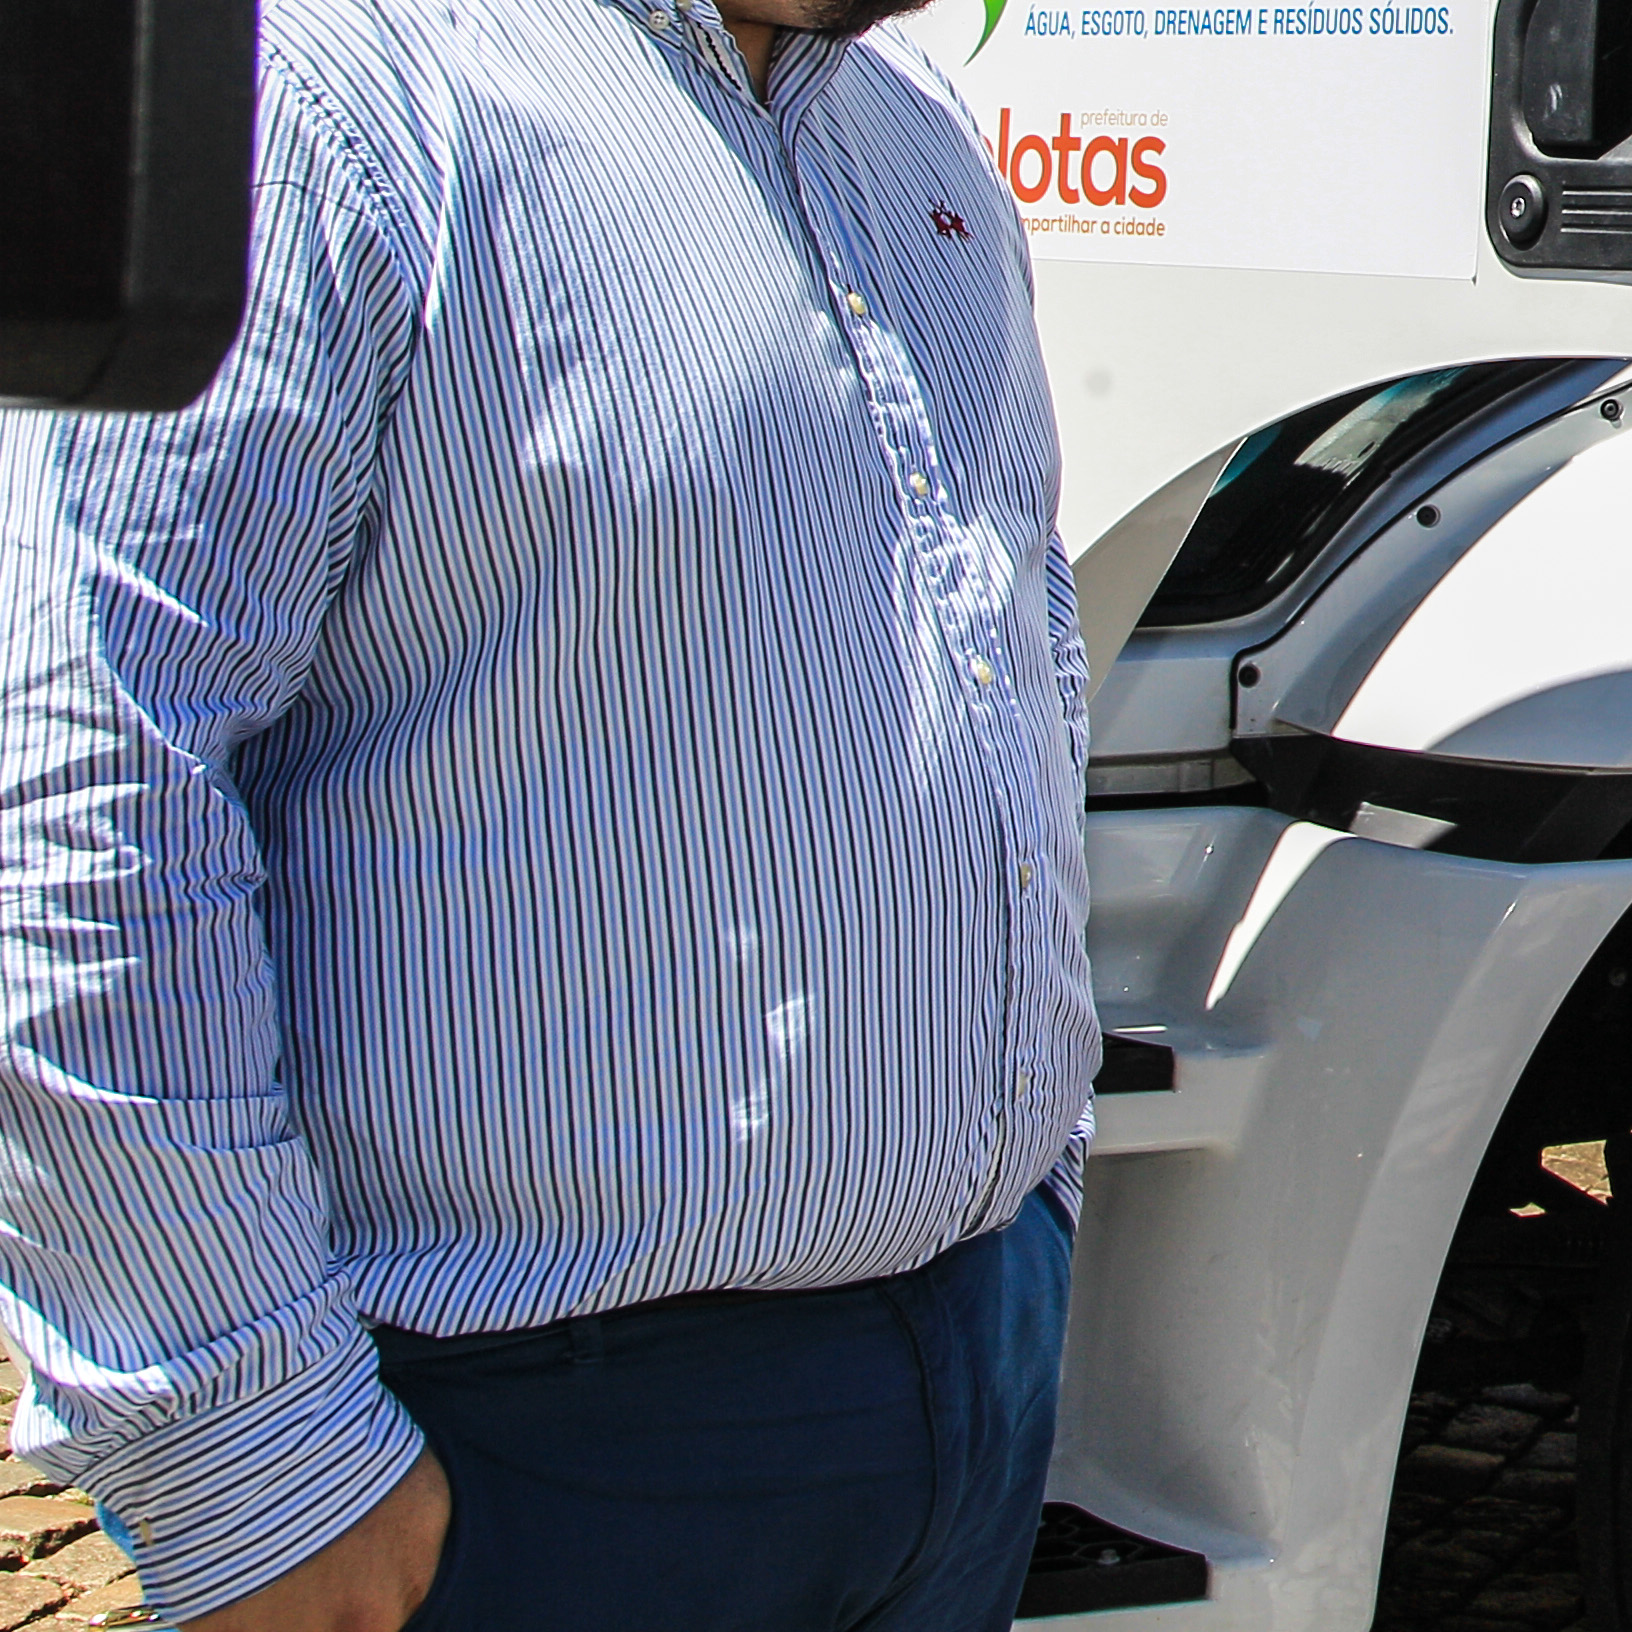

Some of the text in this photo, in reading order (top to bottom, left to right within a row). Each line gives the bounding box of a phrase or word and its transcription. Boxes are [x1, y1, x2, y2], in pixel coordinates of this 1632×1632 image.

[1024, 0, 1454, 39] ÁGUA, ESGOTO, DRENAGEM E RESÍDUOS SÓLIDOS.
[1080, 109, 1168, 129] prefeitura de
[982, 107, 1167, 208] lotas
[1100, 220, 1110, 234] a
[1114, 216, 1166, 236] cidade
